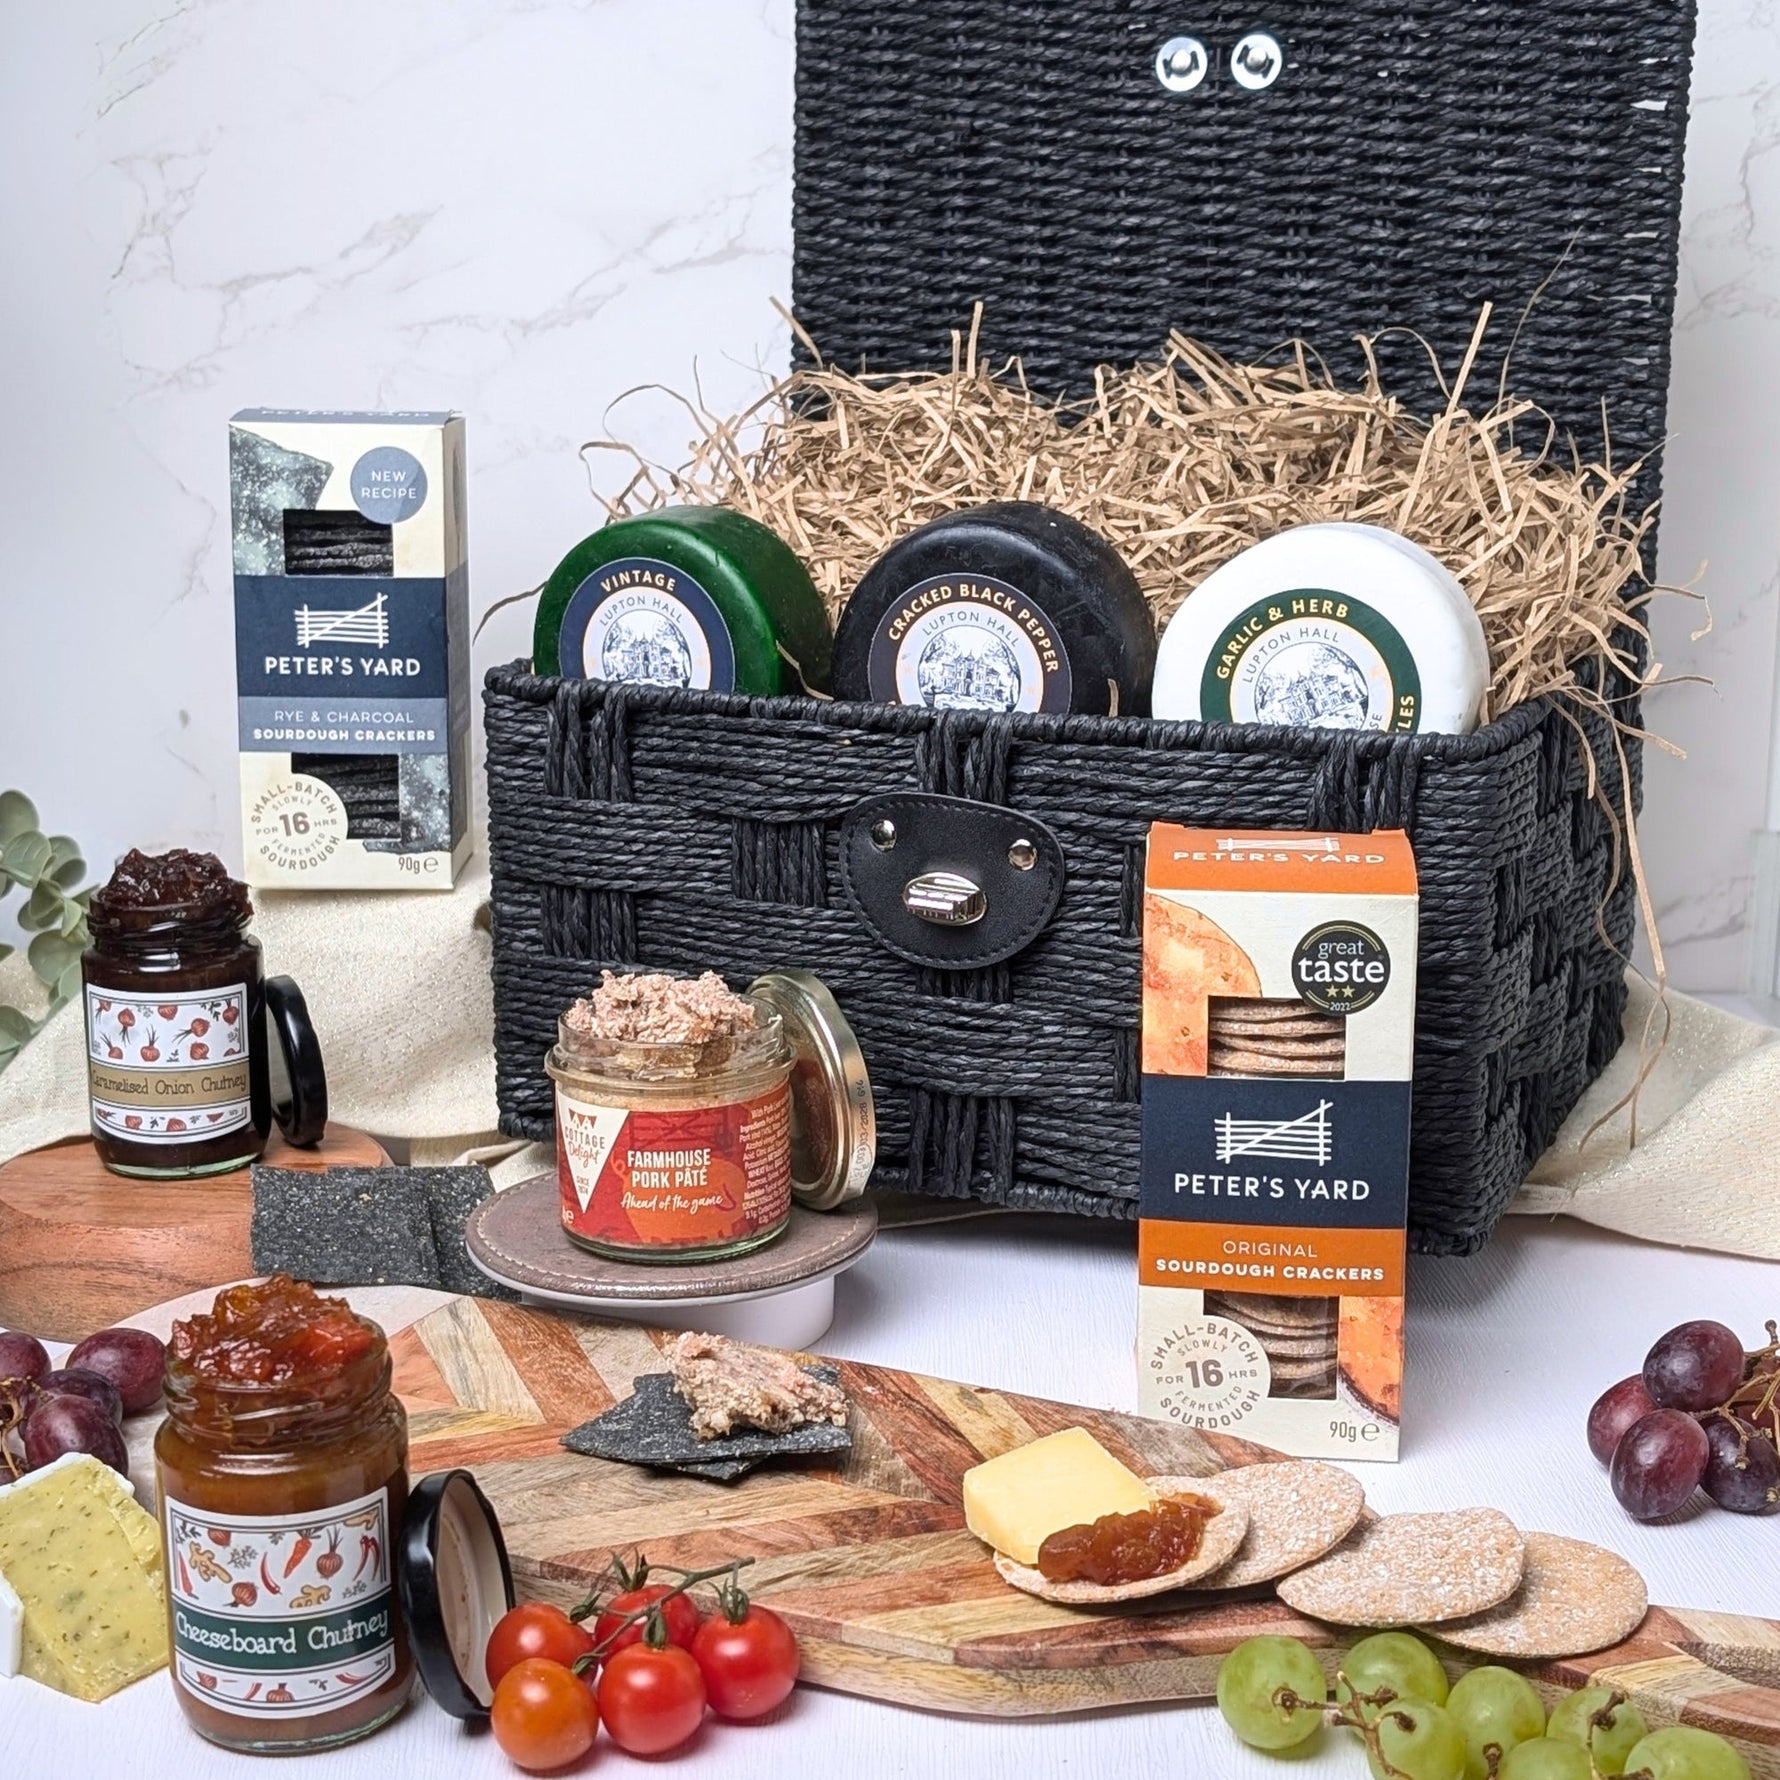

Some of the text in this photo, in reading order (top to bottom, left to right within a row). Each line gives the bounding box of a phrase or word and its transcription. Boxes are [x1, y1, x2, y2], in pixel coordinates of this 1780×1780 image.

[372, 470, 406, 482] NEW
[361, 487, 417, 500] RECIPE
[600, 570, 676, 592] VINTAGE
[599, 595, 682, 626] LUPTON HALL
[888, 584, 1059, 672] CRACKED BLACK PEPPER
[922, 610, 1021, 648] LUPTON HALL
[1216, 599, 1349, 679] GARLIC & HERB
[265, 656, 421, 676] PETER'S YARD
[1242, 627, 1340, 683] LUPTON HALL
[274, 710, 414, 724] RYE & CHARCOAL
[254, 728, 436, 742] SOURDOUGH CRACKERS
[251, 782, 338, 824] SMALL-BATCH
[272, 796, 312, 812] SLOWLY
[256, 826, 278, 836] FOR
[279, 812, 310, 837] 16
[260, 835, 340, 870] SOURDOUGH
[272, 832, 326, 856] FERMENTED
[398, 857, 420, 874] 90g
[1174, 851, 1385, 864] PETER'S YARD
[1318, 940, 1365, 959] great
[1298, 956, 1385, 983] taste
[1329, 1002, 1352, 1012] 2022
[155, 1079, 194, 1096] Onion
[201, 1074, 246, 1093] Chutney
[564, 1126, 605, 1150] COTTAGE
[568, 1140, 600, 1168] Delight
[627, 1148, 711, 1168] FARMHOUSE
[632, 1167, 708, 1188] PORK PÂTÉ
[1174, 1173, 1370, 1200] PETER'S YARD
[620, 1192, 654, 1210] Ahead
[658, 1194, 671, 1210] of
[672, 1194, 690, 1209] the
[692, 1194, 724, 1215] game
[1222, 1240, 1318, 1258] ORIGINAL
[1156, 1259, 1384, 1281] SOURDOUGH CRACKERS
[1150, 1322, 1259, 1370] SMALL-BATCH
[1177, 1338, 1228, 1358] SLOWLY
[1156, 1358, 1258, 1388] FOR 16 HRS
[1160, 1390, 1260, 1429] SOURDOUGH
[1174, 1385, 1242, 1412] FERMENTED
[1329, 1421, 1356, 1442] 90g
[176, 1610, 388, 1654] Cheeseboard Chutney
